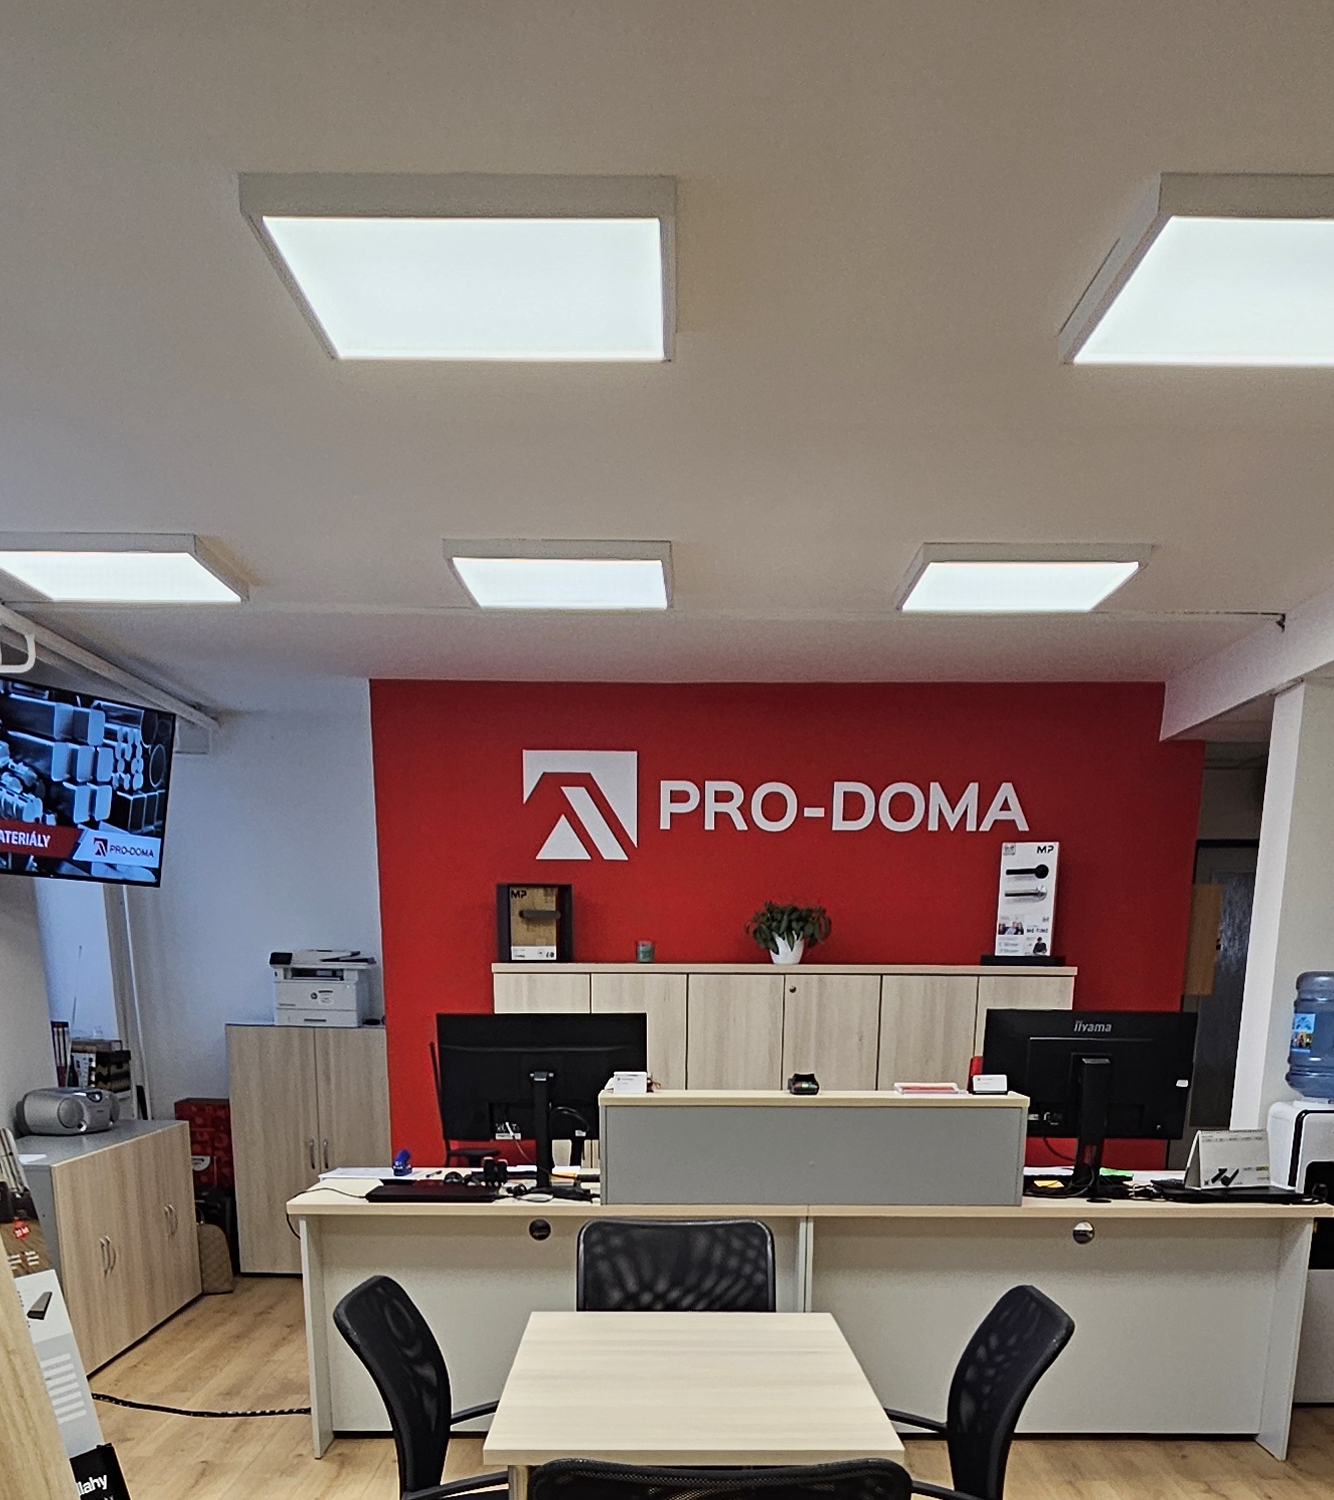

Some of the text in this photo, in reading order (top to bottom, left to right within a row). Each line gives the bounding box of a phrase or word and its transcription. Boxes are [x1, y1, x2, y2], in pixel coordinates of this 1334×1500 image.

[659, 780, 1030, 832] PRO-DOMA
[109, 845, 155, 858] PRO-DOMA
[1036, 845, 1054, 854] MP
[1073, 1020, 1113, 1033] iiyama
